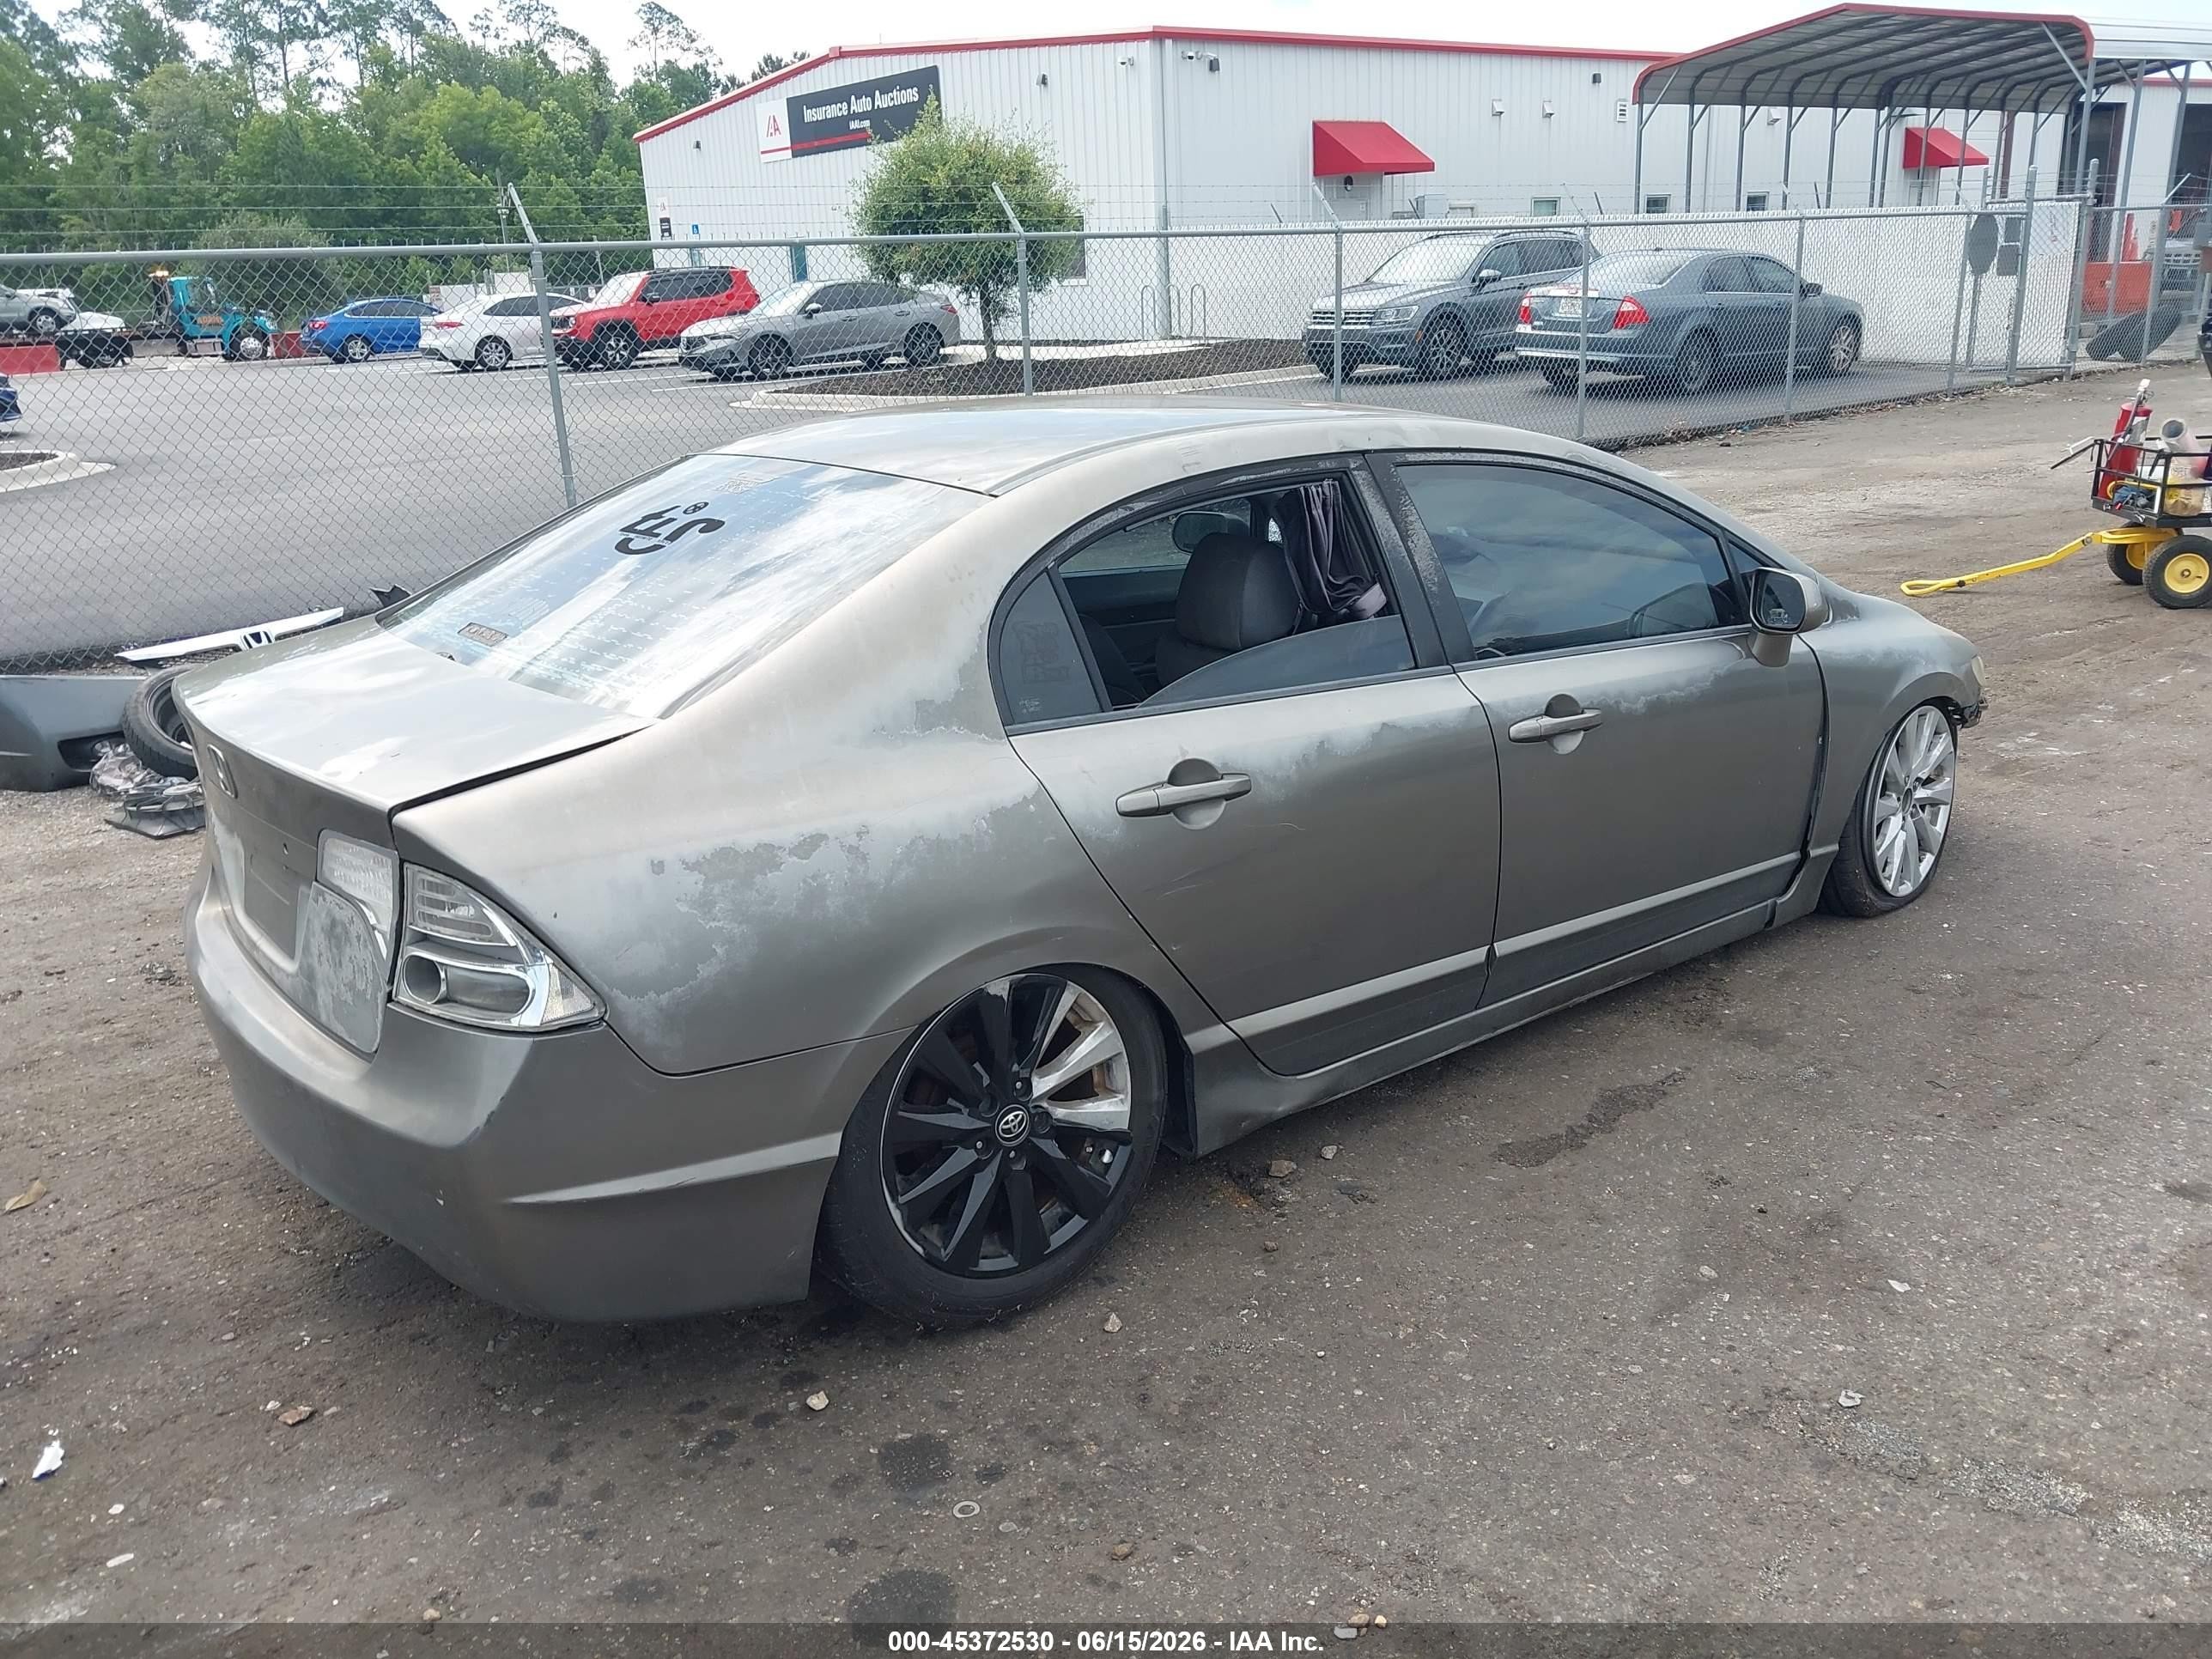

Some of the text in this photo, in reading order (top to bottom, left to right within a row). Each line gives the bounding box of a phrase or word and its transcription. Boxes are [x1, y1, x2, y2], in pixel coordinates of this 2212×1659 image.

[804, 86, 919, 123] Insurance Auto Auctions
